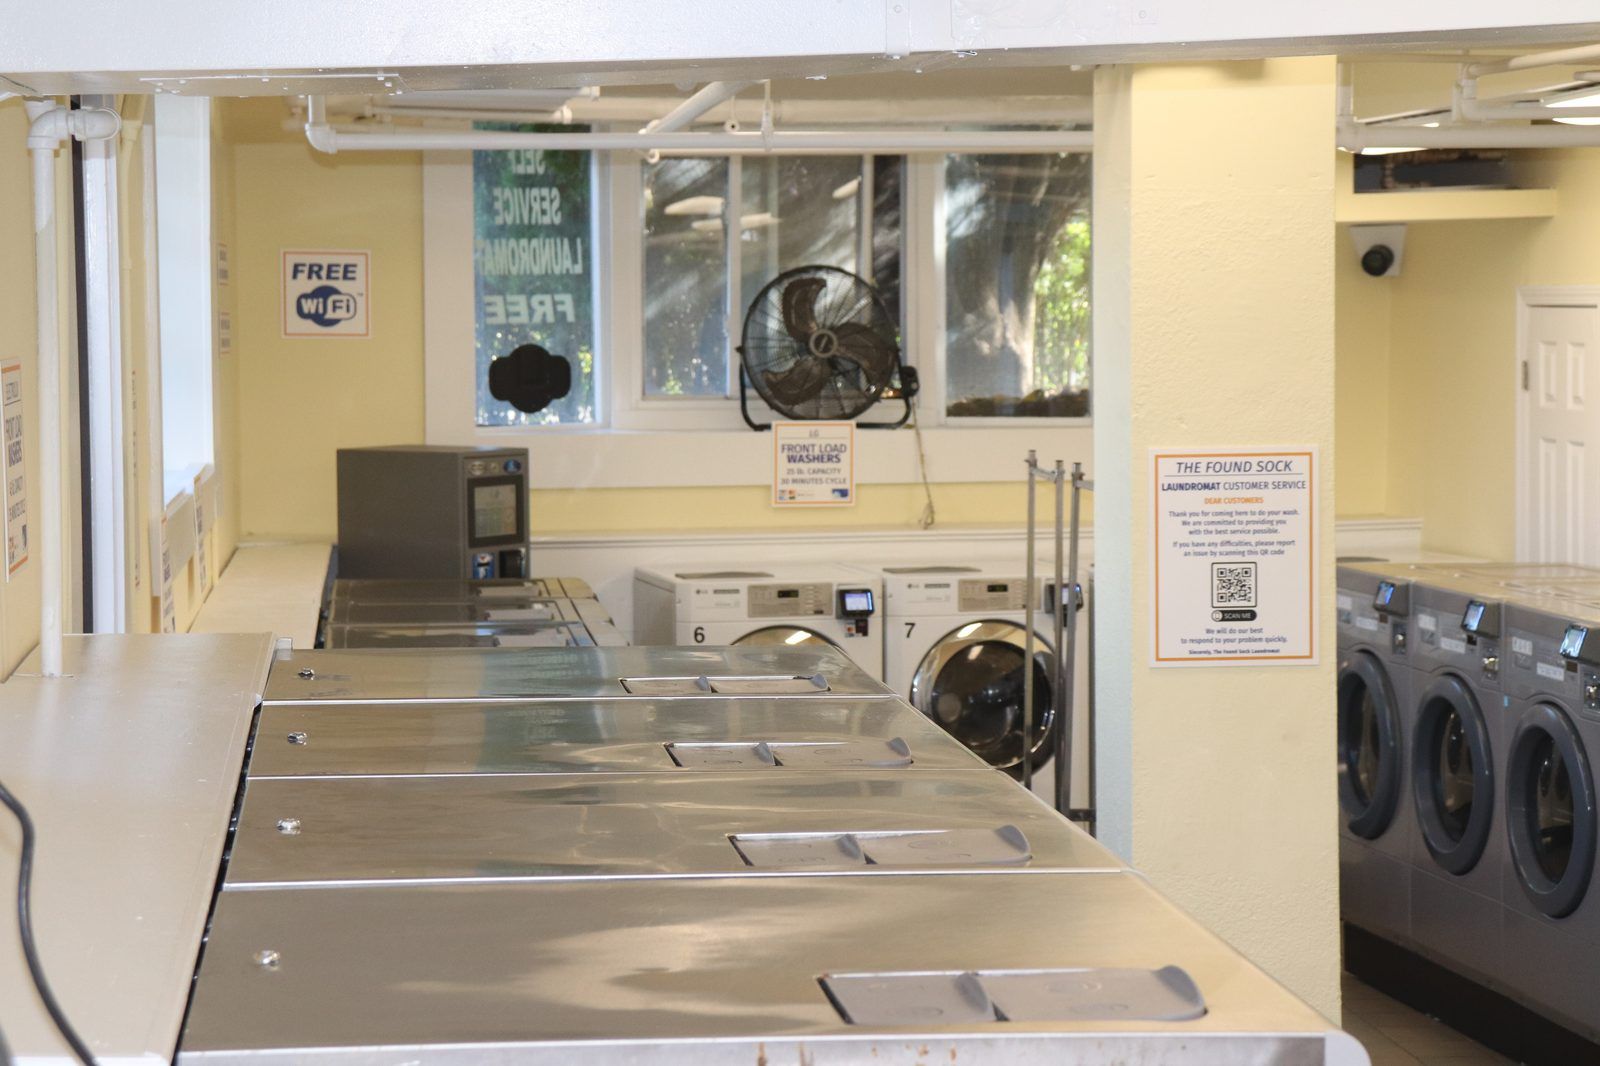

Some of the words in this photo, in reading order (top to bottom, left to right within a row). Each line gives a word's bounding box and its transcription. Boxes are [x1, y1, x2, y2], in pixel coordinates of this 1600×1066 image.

[292, 263, 358, 280] FREE
[781, 444, 816, 454] FRONT
[819, 444, 847, 453] LOAD
[787, 454, 841, 464] WASHERS
[1176, 462, 1202, 473] THE
[1205, 461, 1252, 473] FOUND
[1256, 460, 1293, 472] SOCK
[1162, 482, 1220, 491] LAUNDROMAT
[1223, 482, 1269, 490] CUSTOMER
[1272, 480, 1306, 490] SERVICE
[694, 626, 705, 643] 6
[904, 622, 916, 638] 7
